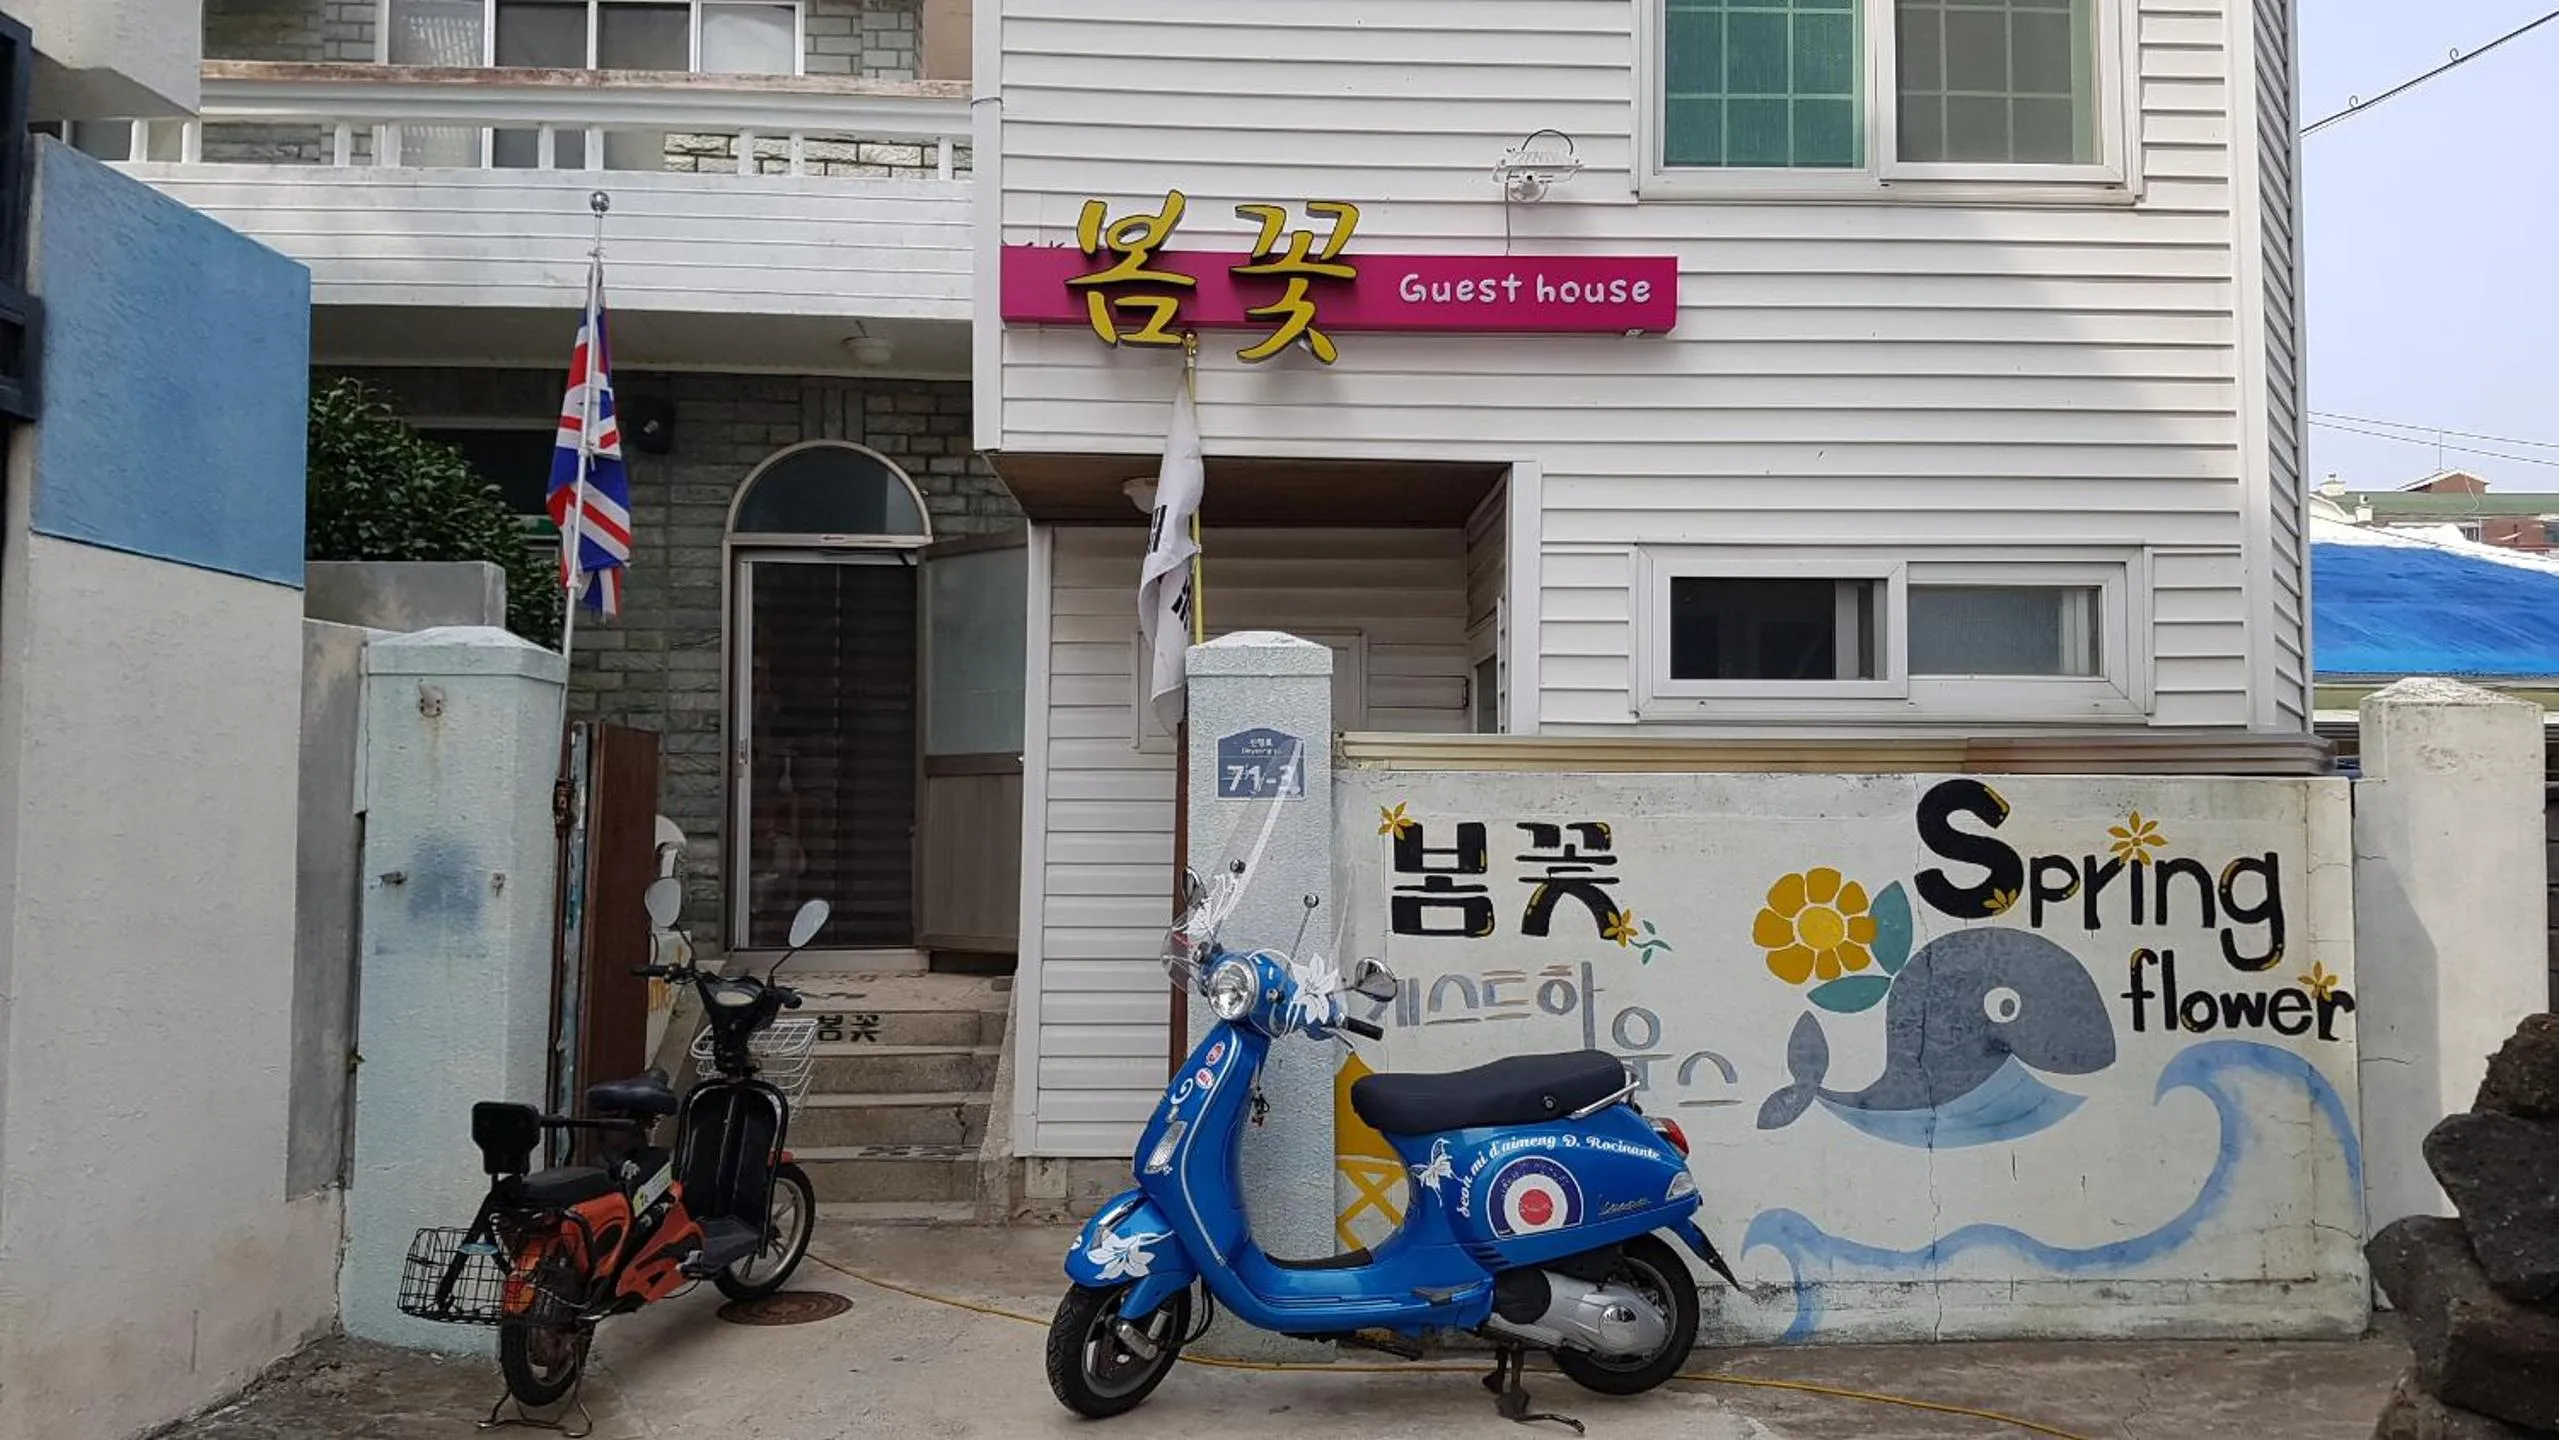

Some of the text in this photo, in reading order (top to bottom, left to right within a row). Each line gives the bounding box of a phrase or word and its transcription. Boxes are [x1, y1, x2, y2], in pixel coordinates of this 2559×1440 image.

[1399, 272, 1522, 305] Guest
[1536, 275, 1652, 305] house
[1914, 778, 2286, 972] Spring
[2121, 947, 2355, 1042] flower
[1562, 1134, 1581, 1148] D.
[1586, 1135, 1662, 1161] Rocinante
